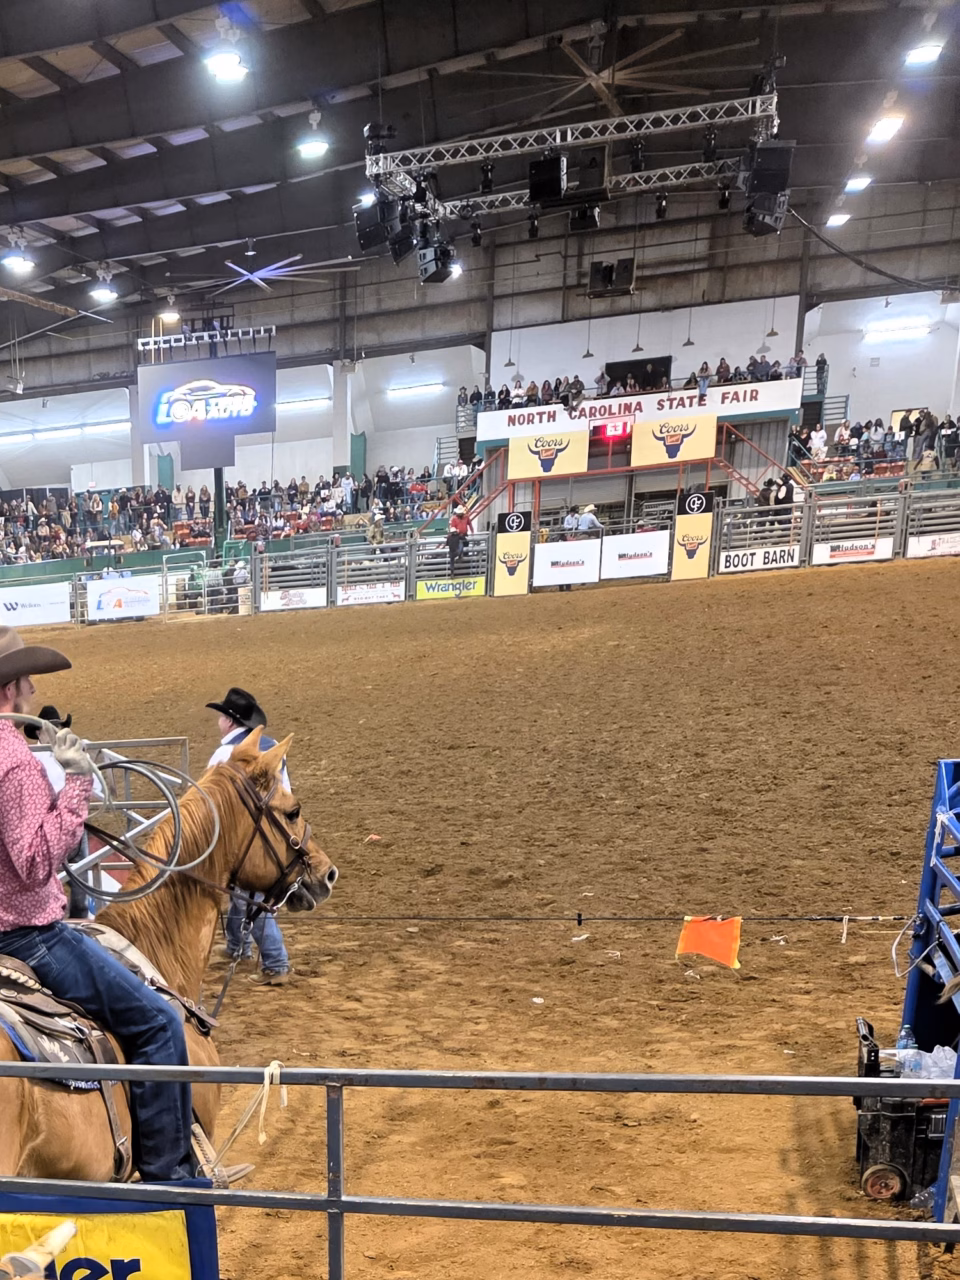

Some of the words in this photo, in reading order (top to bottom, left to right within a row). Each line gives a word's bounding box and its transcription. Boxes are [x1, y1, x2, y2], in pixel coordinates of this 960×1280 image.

[507, 410, 557, 427] NORTH
[569, 401, 643, 420] CAROLINA
[657, 394, 707, 411] STATE
[721, 389, 759, 404] FAIR
[659, 422, 690, 434] Coors
[534, 437, 563, 448] Coors
[682, 534, 704, 542] Coors
[724, 552, 757, 569] BOOT
[763, 548, 795, 565] BARN
[425, 580, 478, 598] Wrangler
